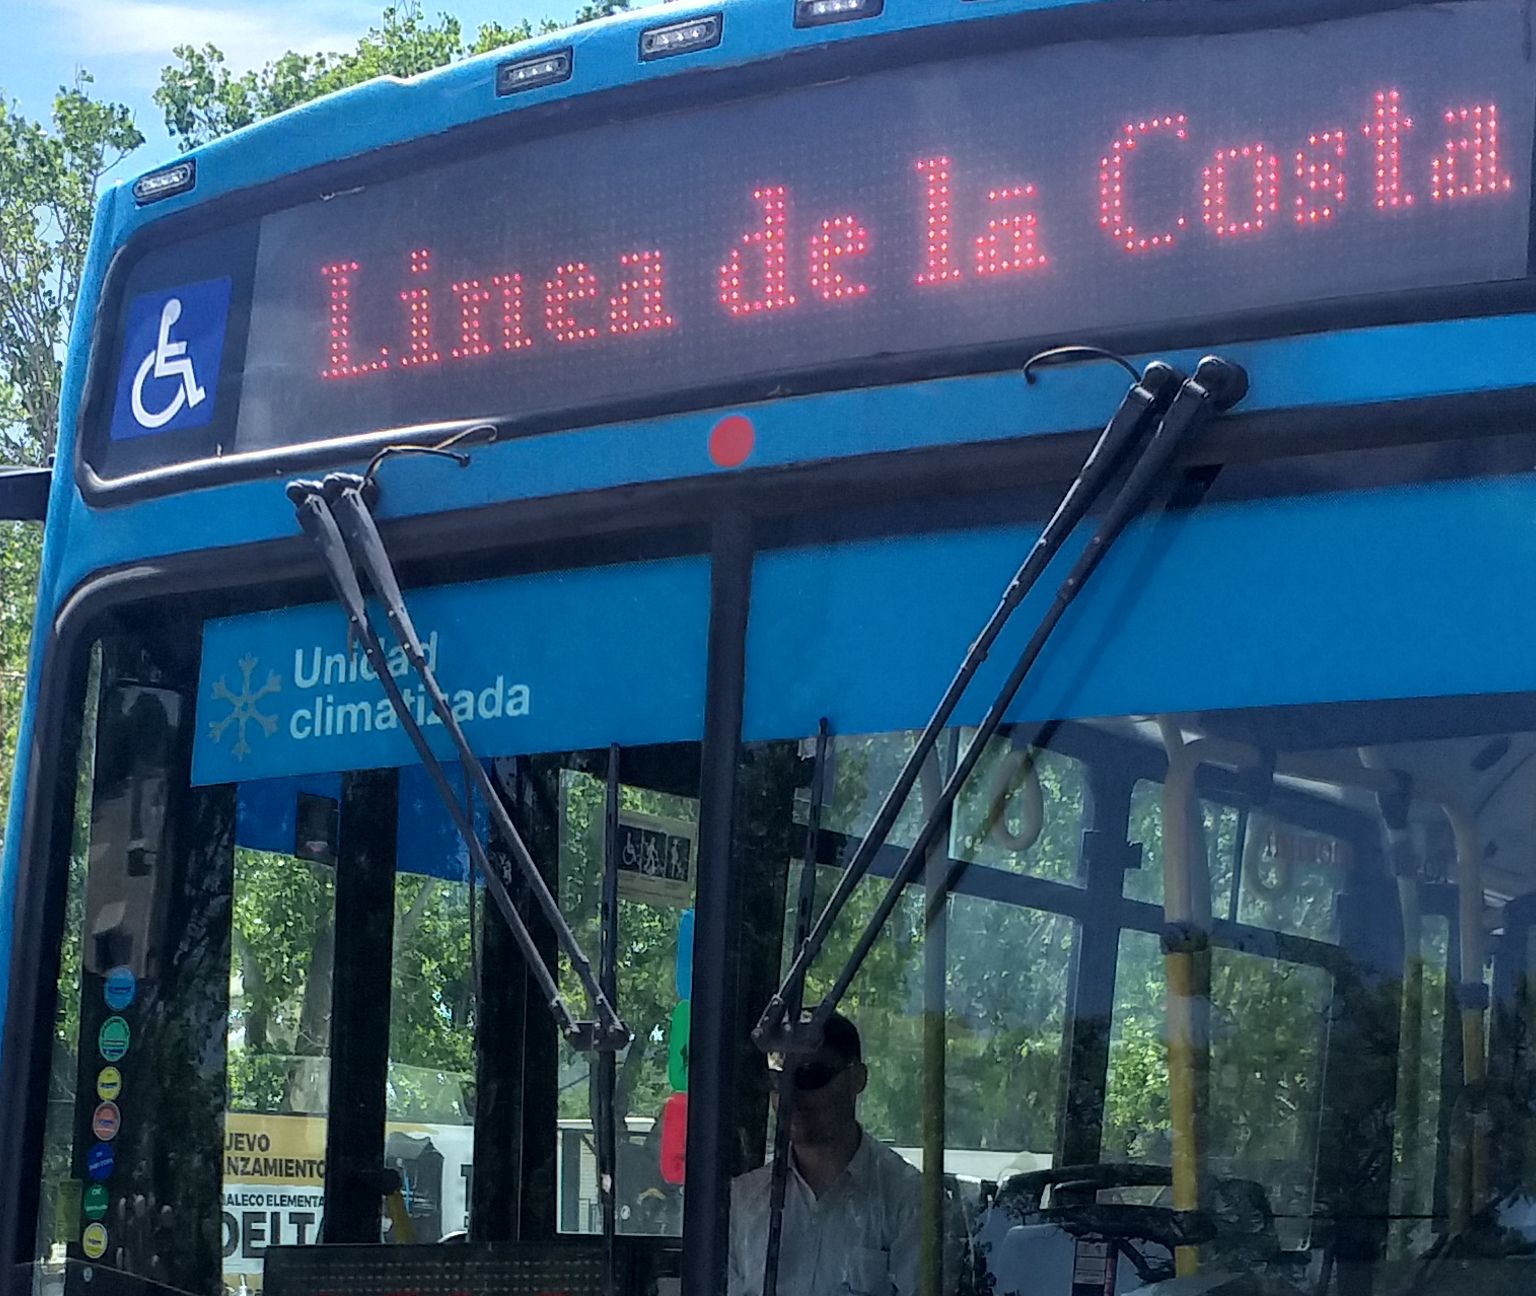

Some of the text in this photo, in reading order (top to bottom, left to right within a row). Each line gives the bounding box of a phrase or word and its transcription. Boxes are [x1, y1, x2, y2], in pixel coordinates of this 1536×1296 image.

[718, 186, 867, 317] de
[914, 156, 1047, 286] la
[1098, 88, 1512, 252] Costa
[224, 1156, 325, 1178] NZAMIENTO
